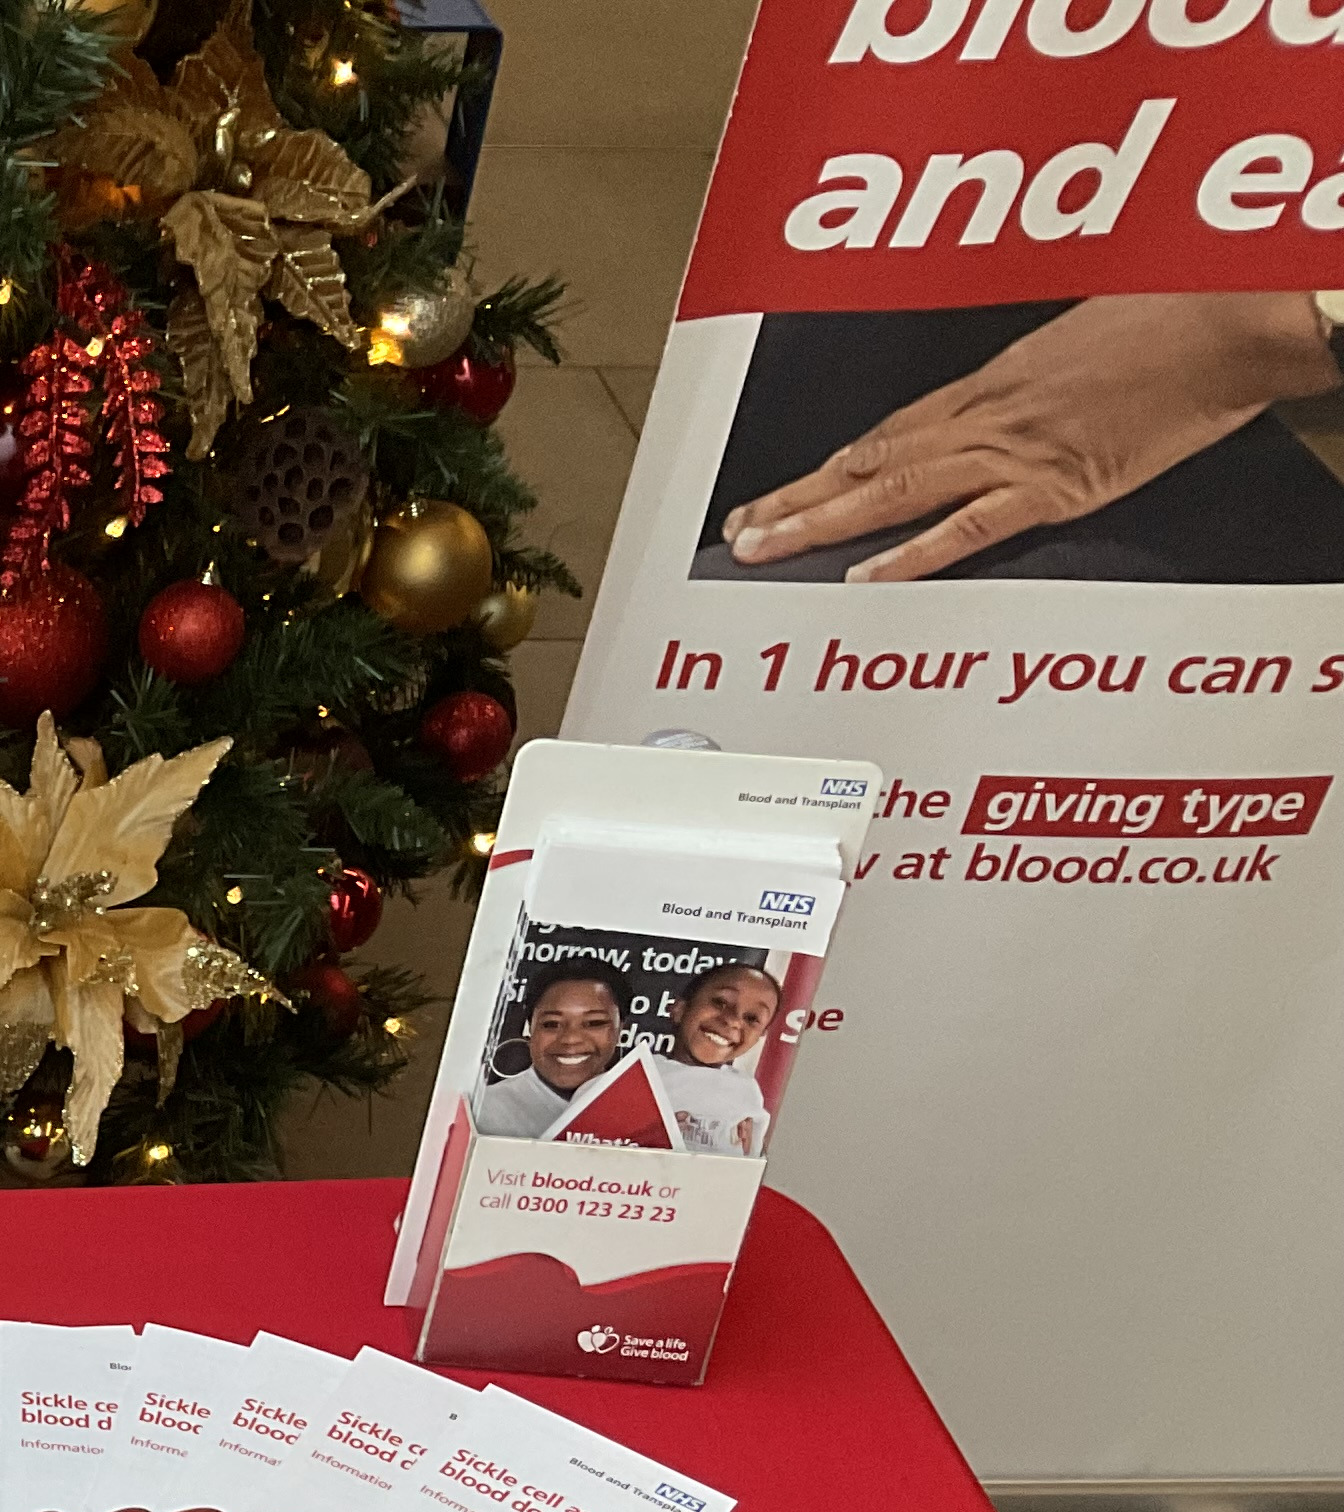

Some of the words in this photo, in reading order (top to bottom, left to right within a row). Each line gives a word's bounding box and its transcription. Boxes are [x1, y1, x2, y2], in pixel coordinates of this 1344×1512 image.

[784, 97, 1177, 250] and
[655, 639, 722, 690] In
[760, 642, 789, 691] 1
[813, 638, 989, 691] hour
[997, 652, 1146, 704] you
[1167, 656, 1291, 694] can
[984, 781, 1164, 826] giving
[1182, 788, 1304, 826] type
[892, 846, 951, 880] at
[964, 842, 1280, 883] blood.co.uk
[661, 902, 702, 916] Blood
[705, 909, 732, 920] and
[736, 911, 807, 930] Transplant
[762, 890, 813, 915] NHS
[487, 1169, 526, 1186] Visit
[531, 1171, 653, 1196] blood.co.uk
[658, 1186, 679, 1197] or
[479, 1193, 511, 1208] call
[516, 1195, 568, 1213] 0300
[577, 1200, 612, 1217] 123
[617, 1203, 644, 1219] 23
[649, 1206, 676, 1222] 23
[439, 1461, 510, 1502] blood
[452, 1449, 517, 1486] Sickle
[521, 1485, 564, 1508] cell
